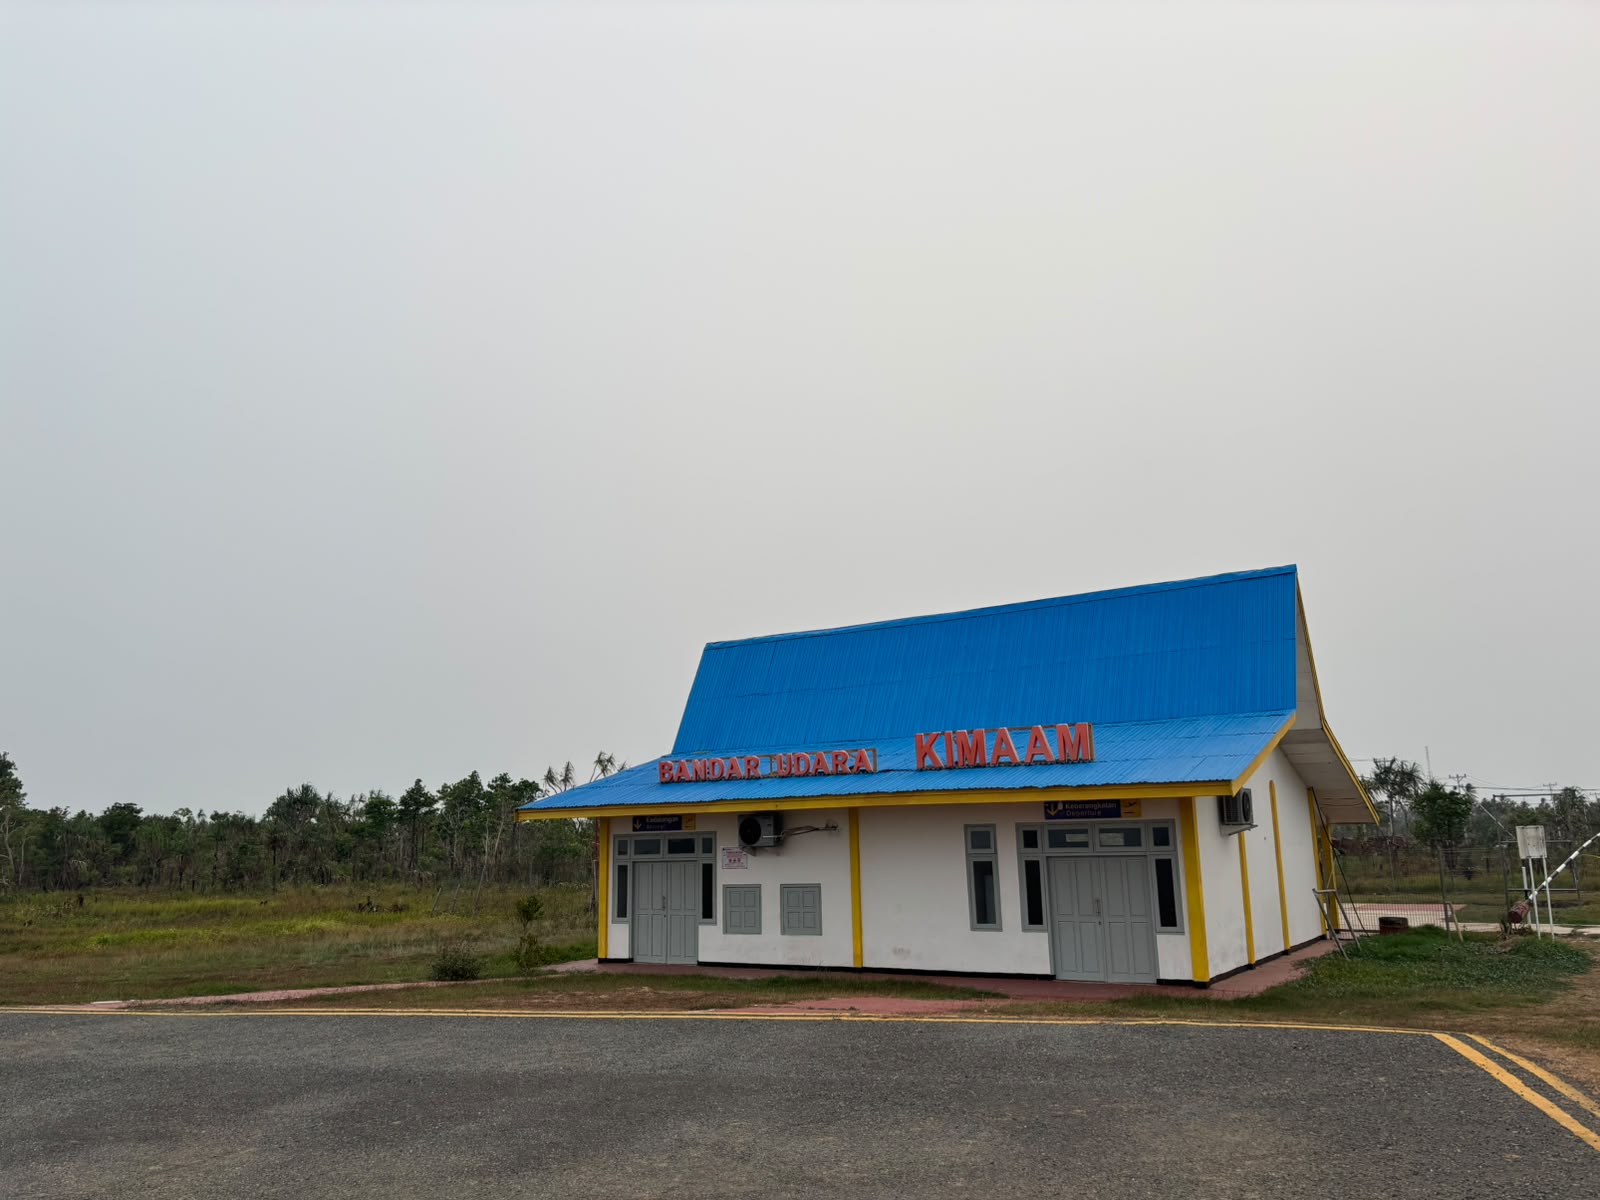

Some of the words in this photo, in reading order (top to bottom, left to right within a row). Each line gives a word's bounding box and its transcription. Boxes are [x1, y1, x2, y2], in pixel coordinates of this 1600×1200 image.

[658, 756, 761, 783] BANDAR
[776, 749, 874, 776] UDARA
[914, 722, 1091, 769] KIMAAM
[1066, 809, 1102, 817] Departure
